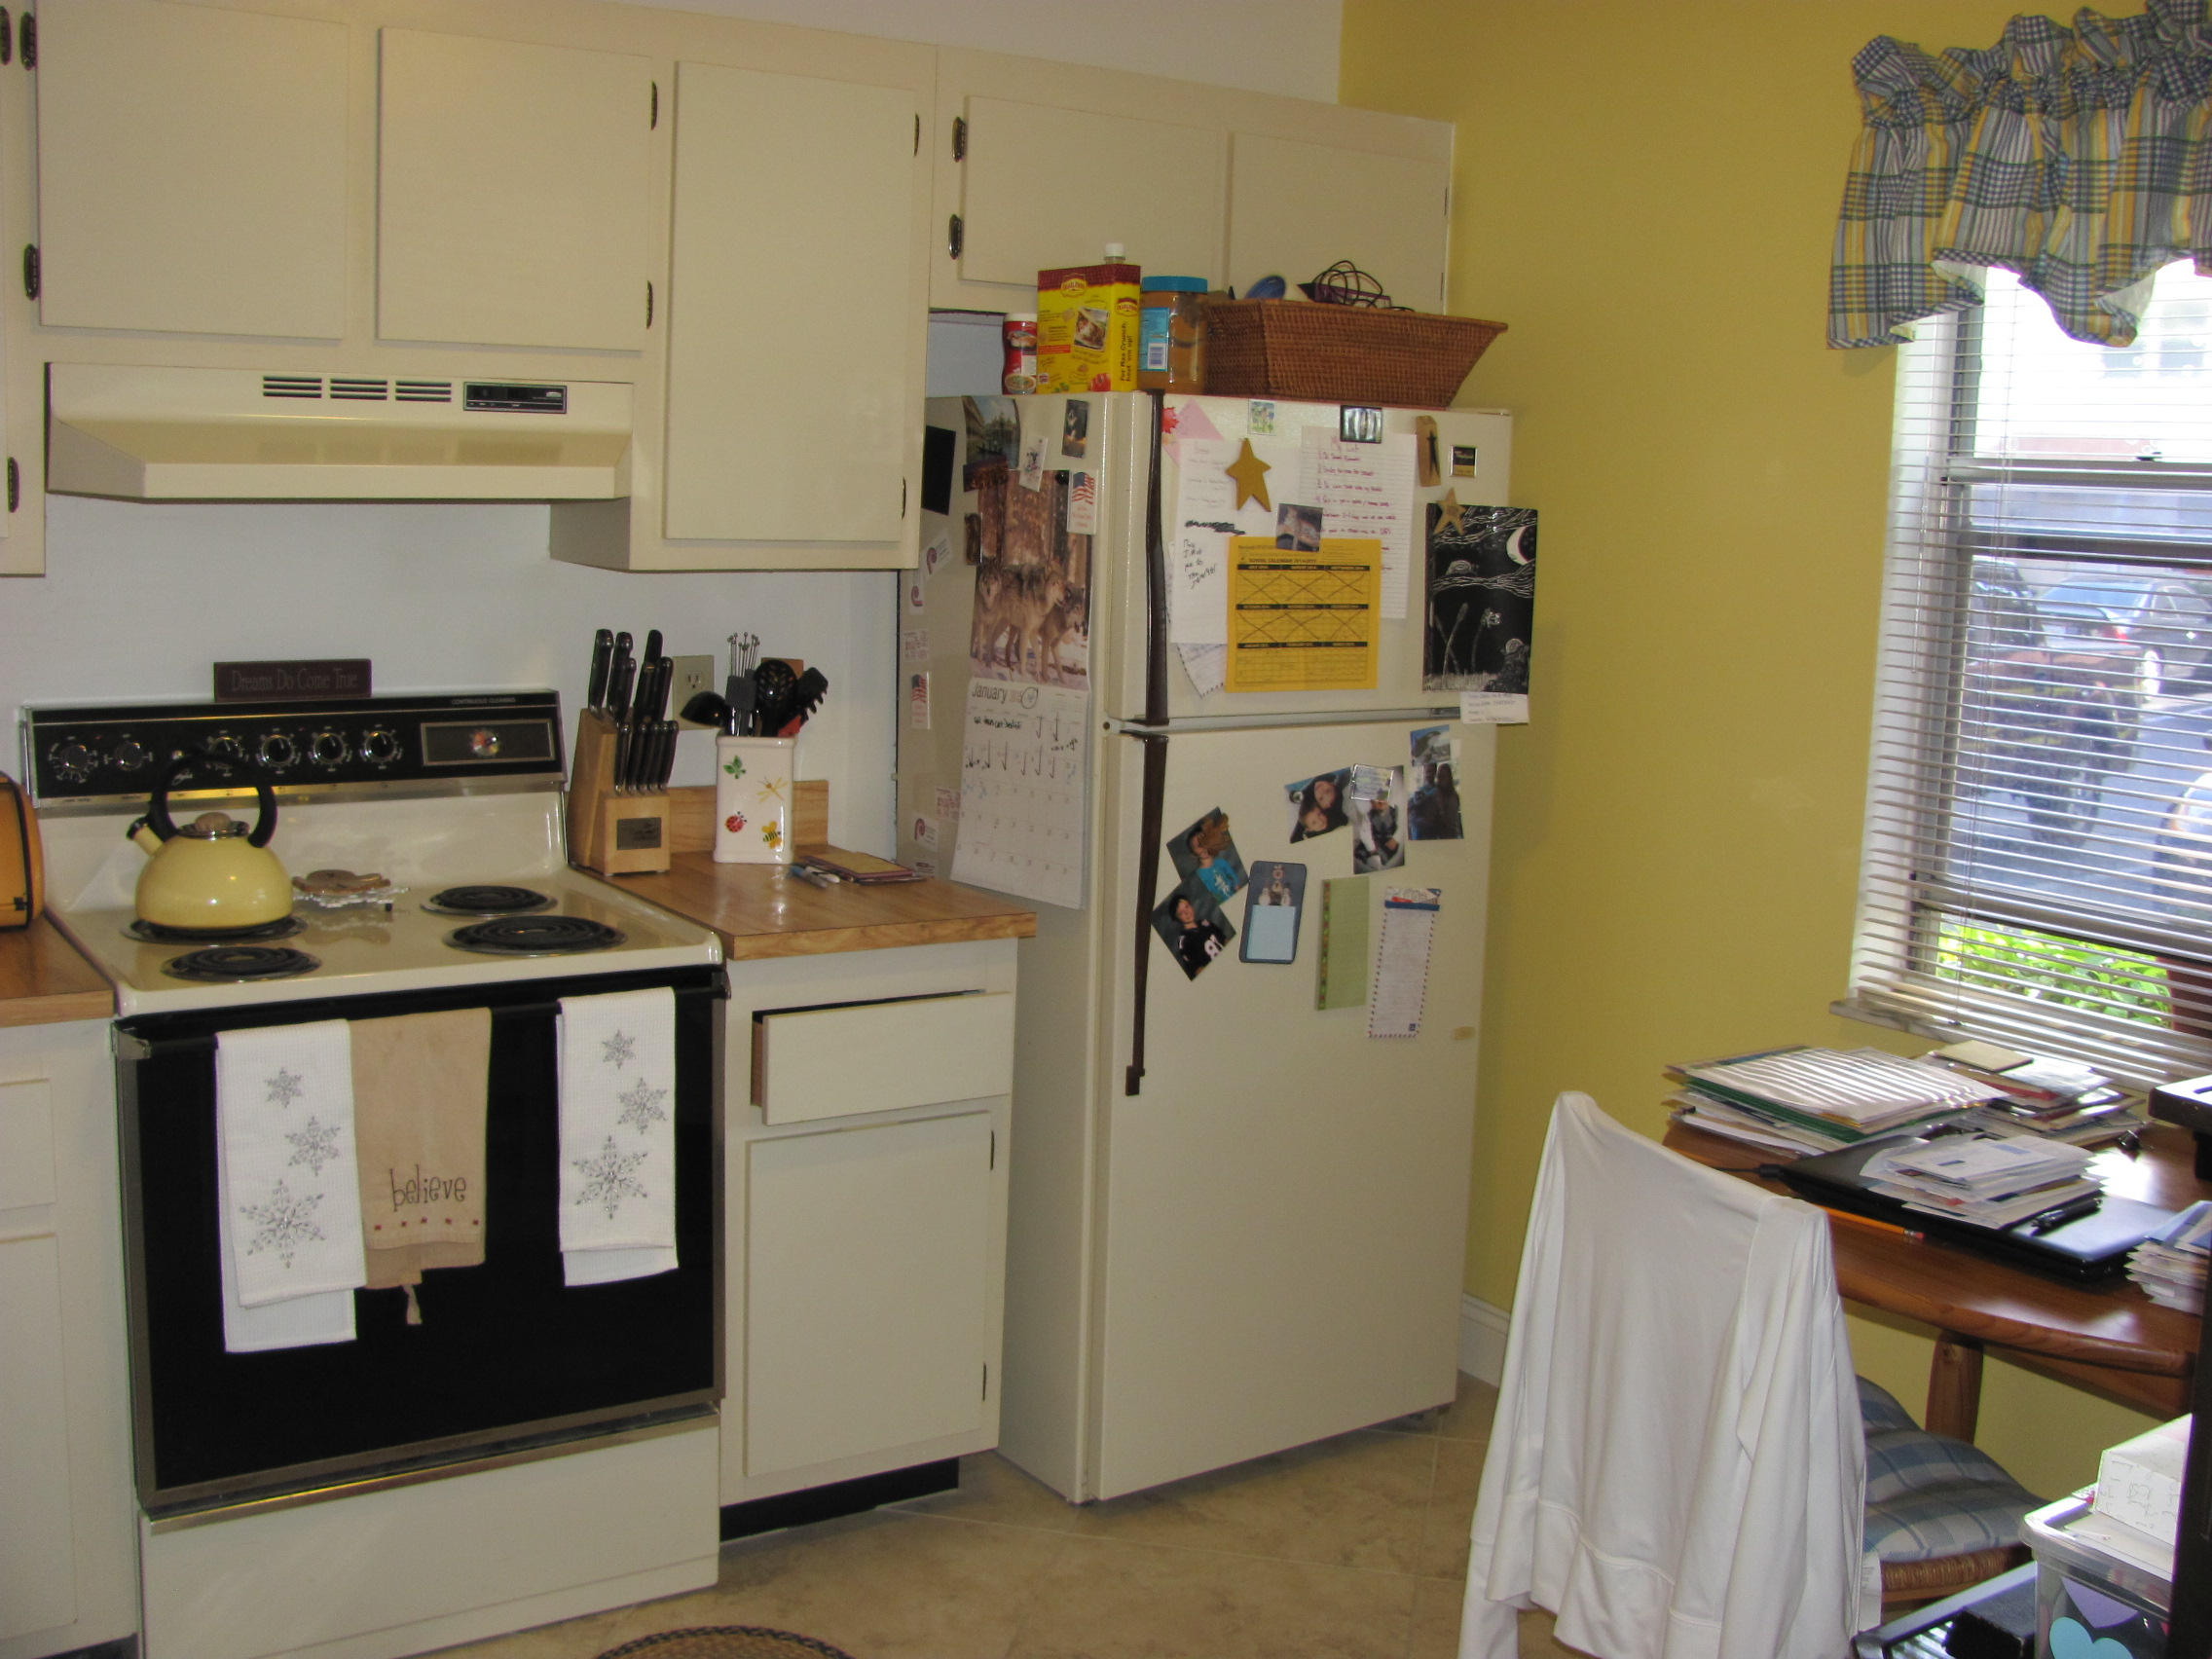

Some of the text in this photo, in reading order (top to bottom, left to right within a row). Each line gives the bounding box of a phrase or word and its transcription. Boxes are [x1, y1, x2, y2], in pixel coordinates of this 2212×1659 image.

[232, 667, 358, 693] Dreams Do Come True
[972, 682, 1007, 704] January
[389, 1163, 467, 1213] believe
